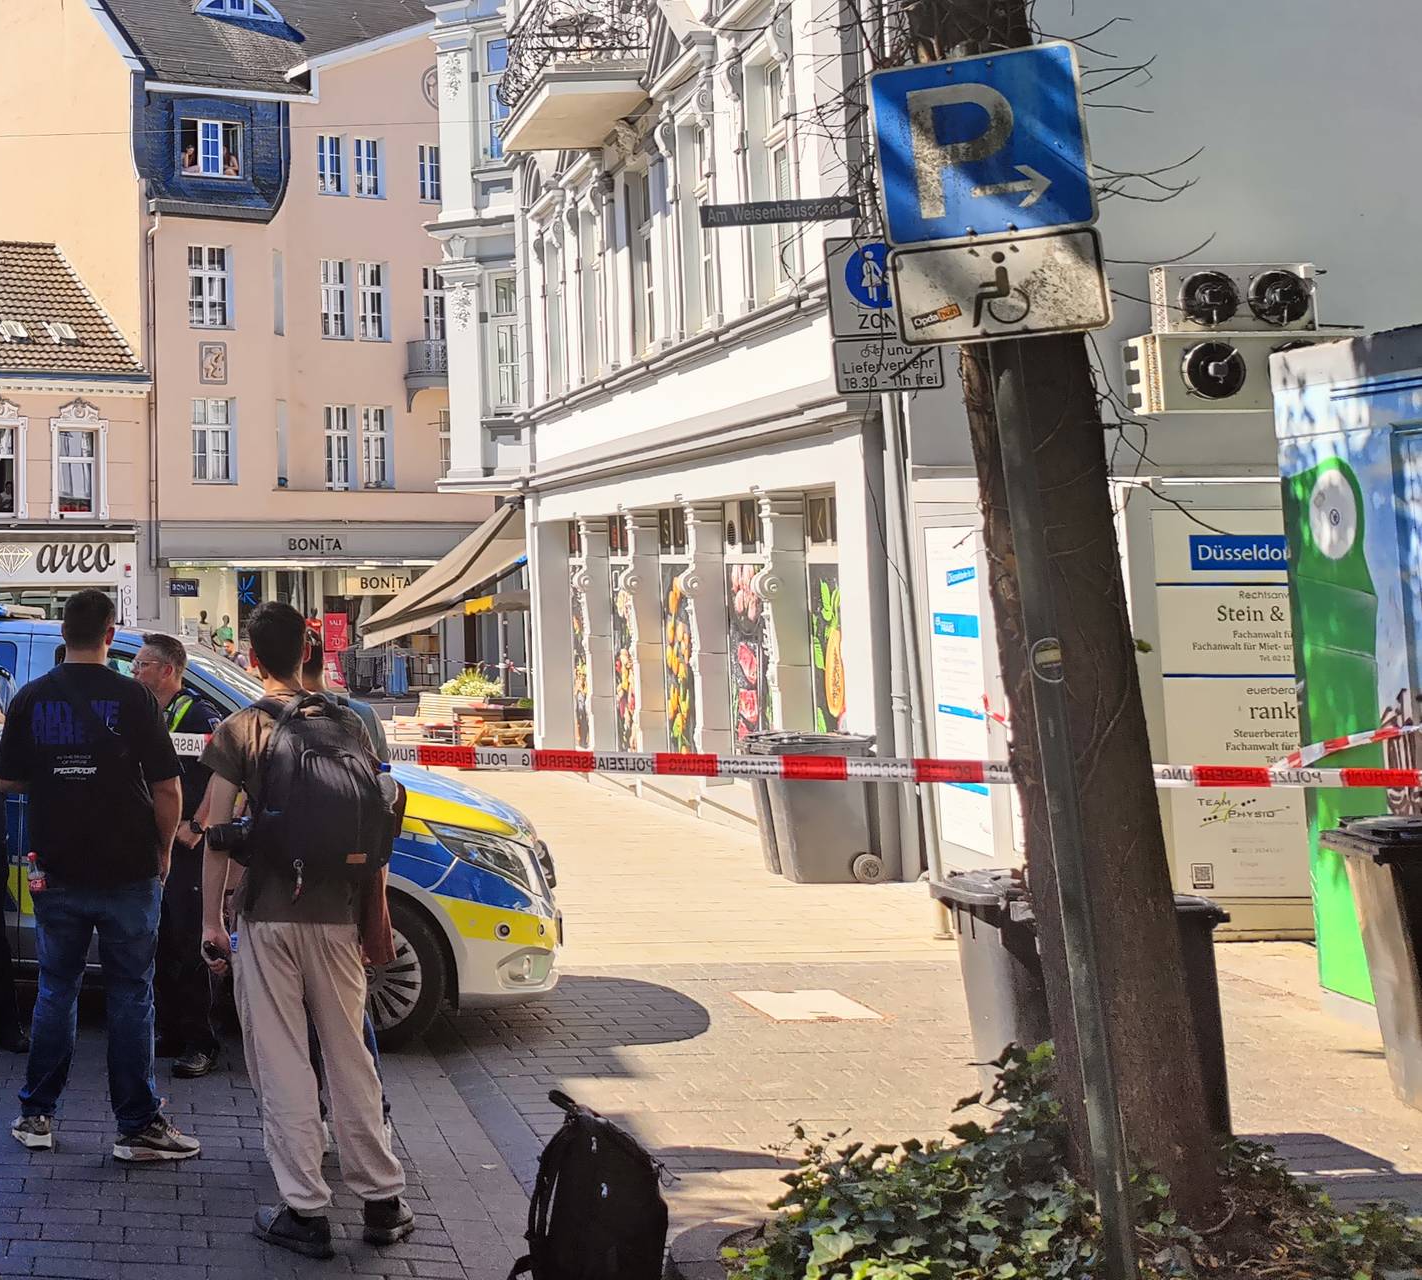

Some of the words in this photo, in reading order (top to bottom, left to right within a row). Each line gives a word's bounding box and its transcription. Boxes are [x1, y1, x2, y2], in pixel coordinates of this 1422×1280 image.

[906, 82, 1015, 219] P
[707, 208, 728, 223] Am
[36, 543, 116, 574] areo
[1217, 605, 1264, 622] Stein
[1269, 605, 1285, 622] &
[1233, 630, 1282, 639] Fachanwalt
[1192, 642, 1241, 651] Fachanwalt
[1243, 642, 1256, 651] für
[1233, 729, 1299, 739] Steuerberater
[1225, 742, 1279, 752] Fachanwalt
